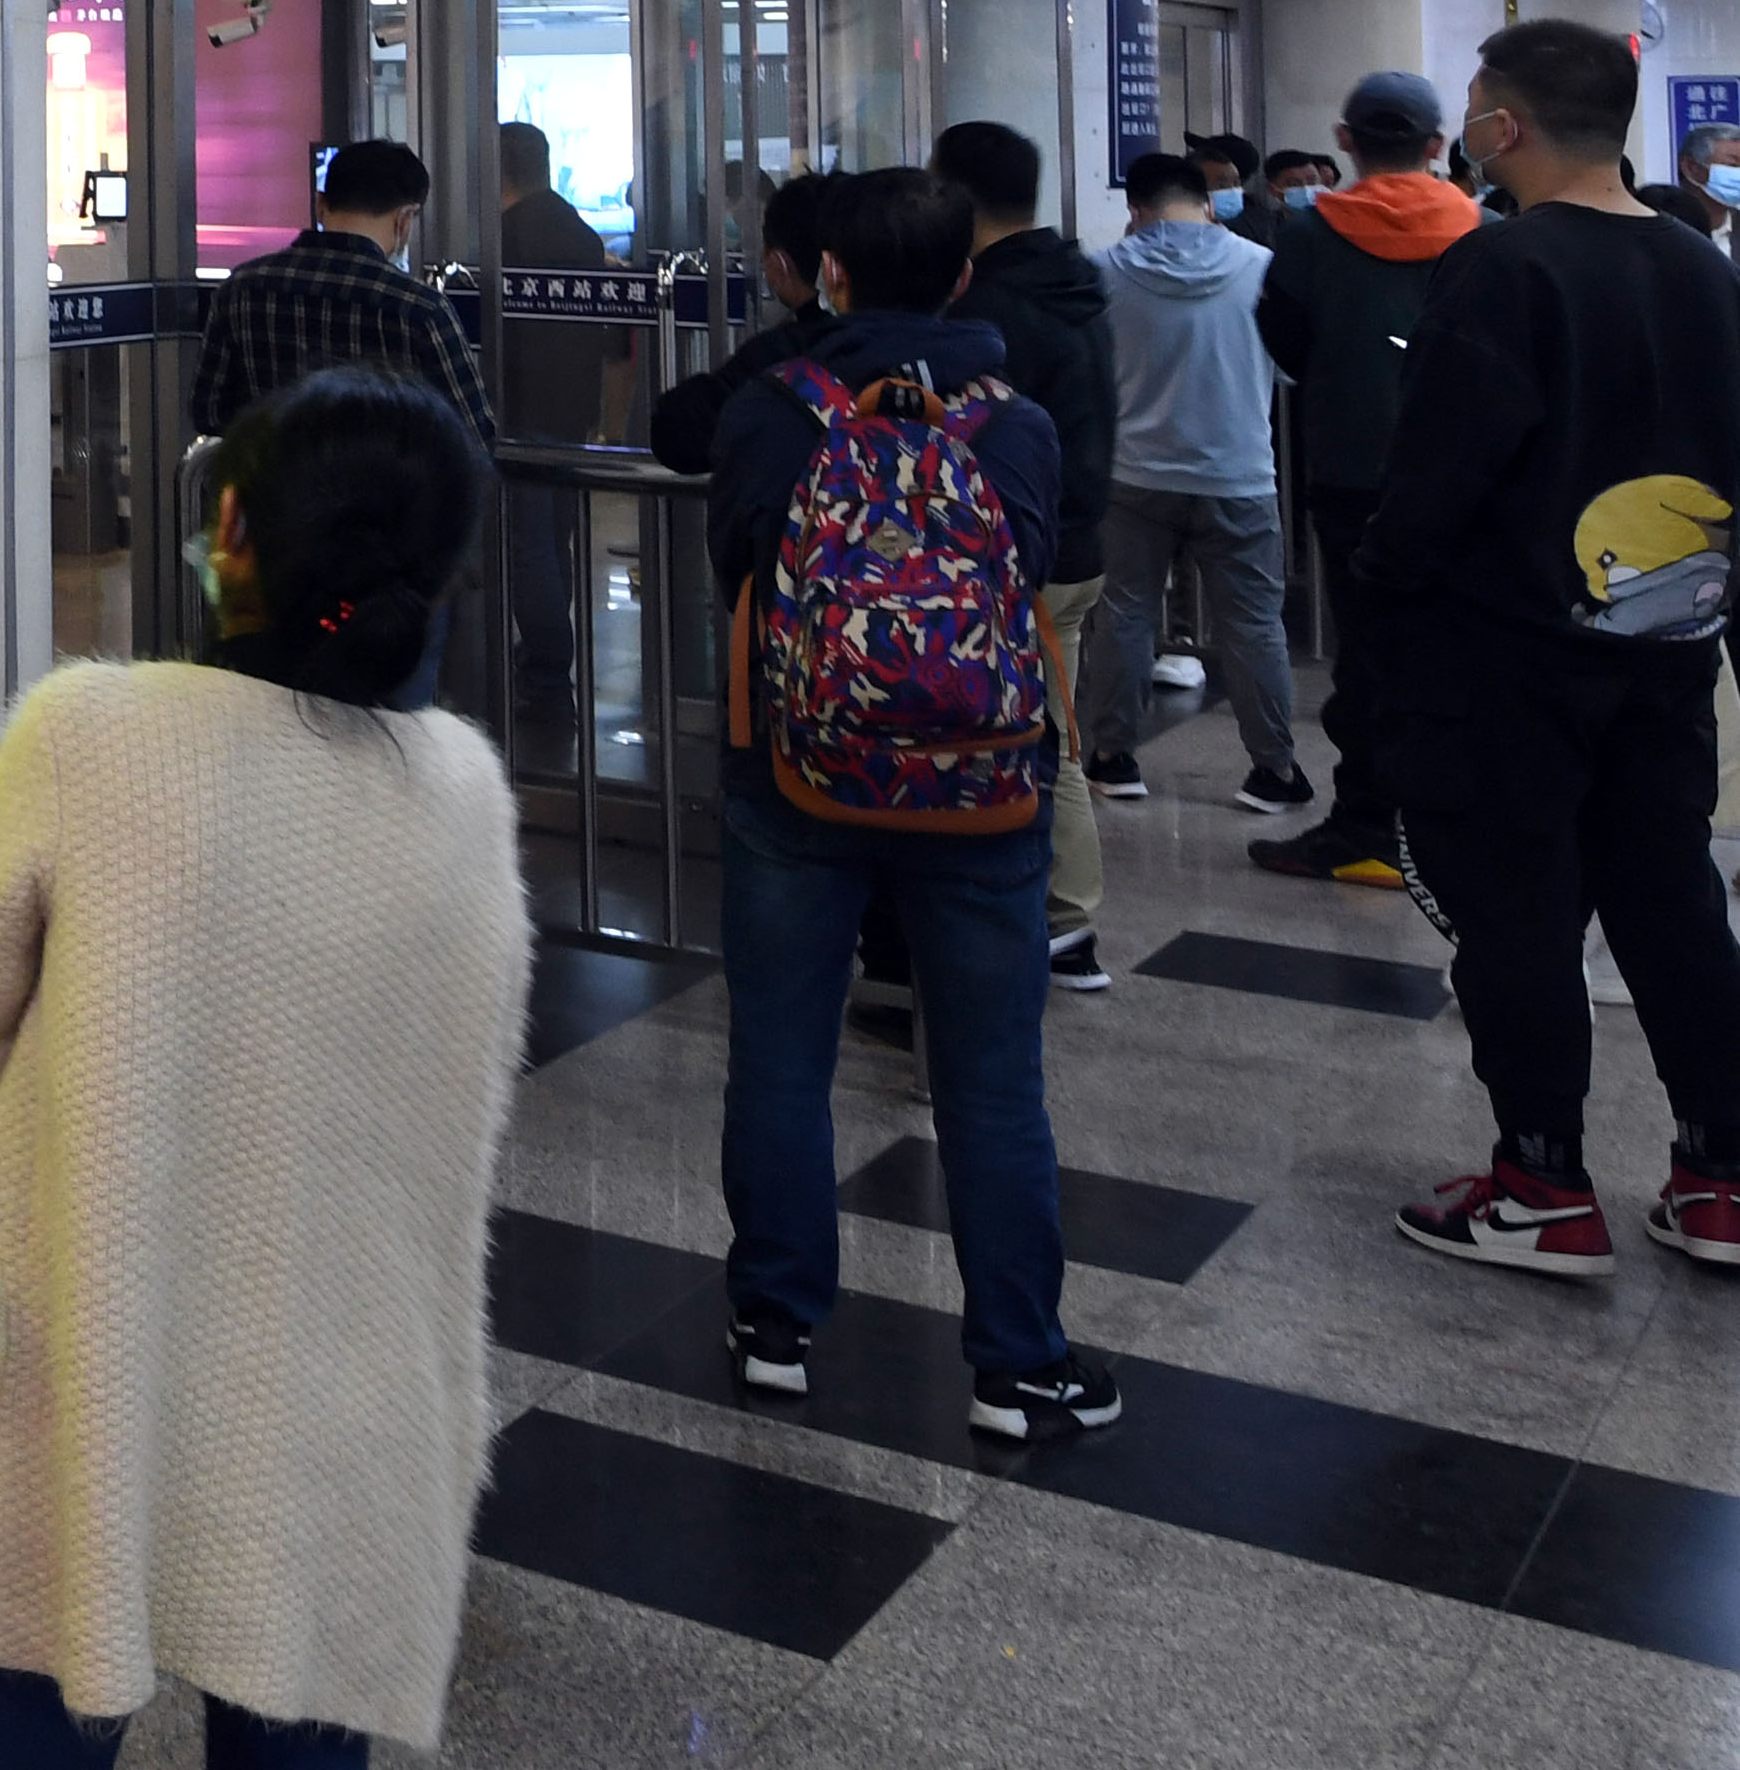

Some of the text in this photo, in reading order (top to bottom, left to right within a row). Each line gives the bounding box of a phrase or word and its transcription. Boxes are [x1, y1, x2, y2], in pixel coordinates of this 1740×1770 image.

[502, 276, 659, 303] 北京西站欢迎
[503, 298, 534, 310] elcome
